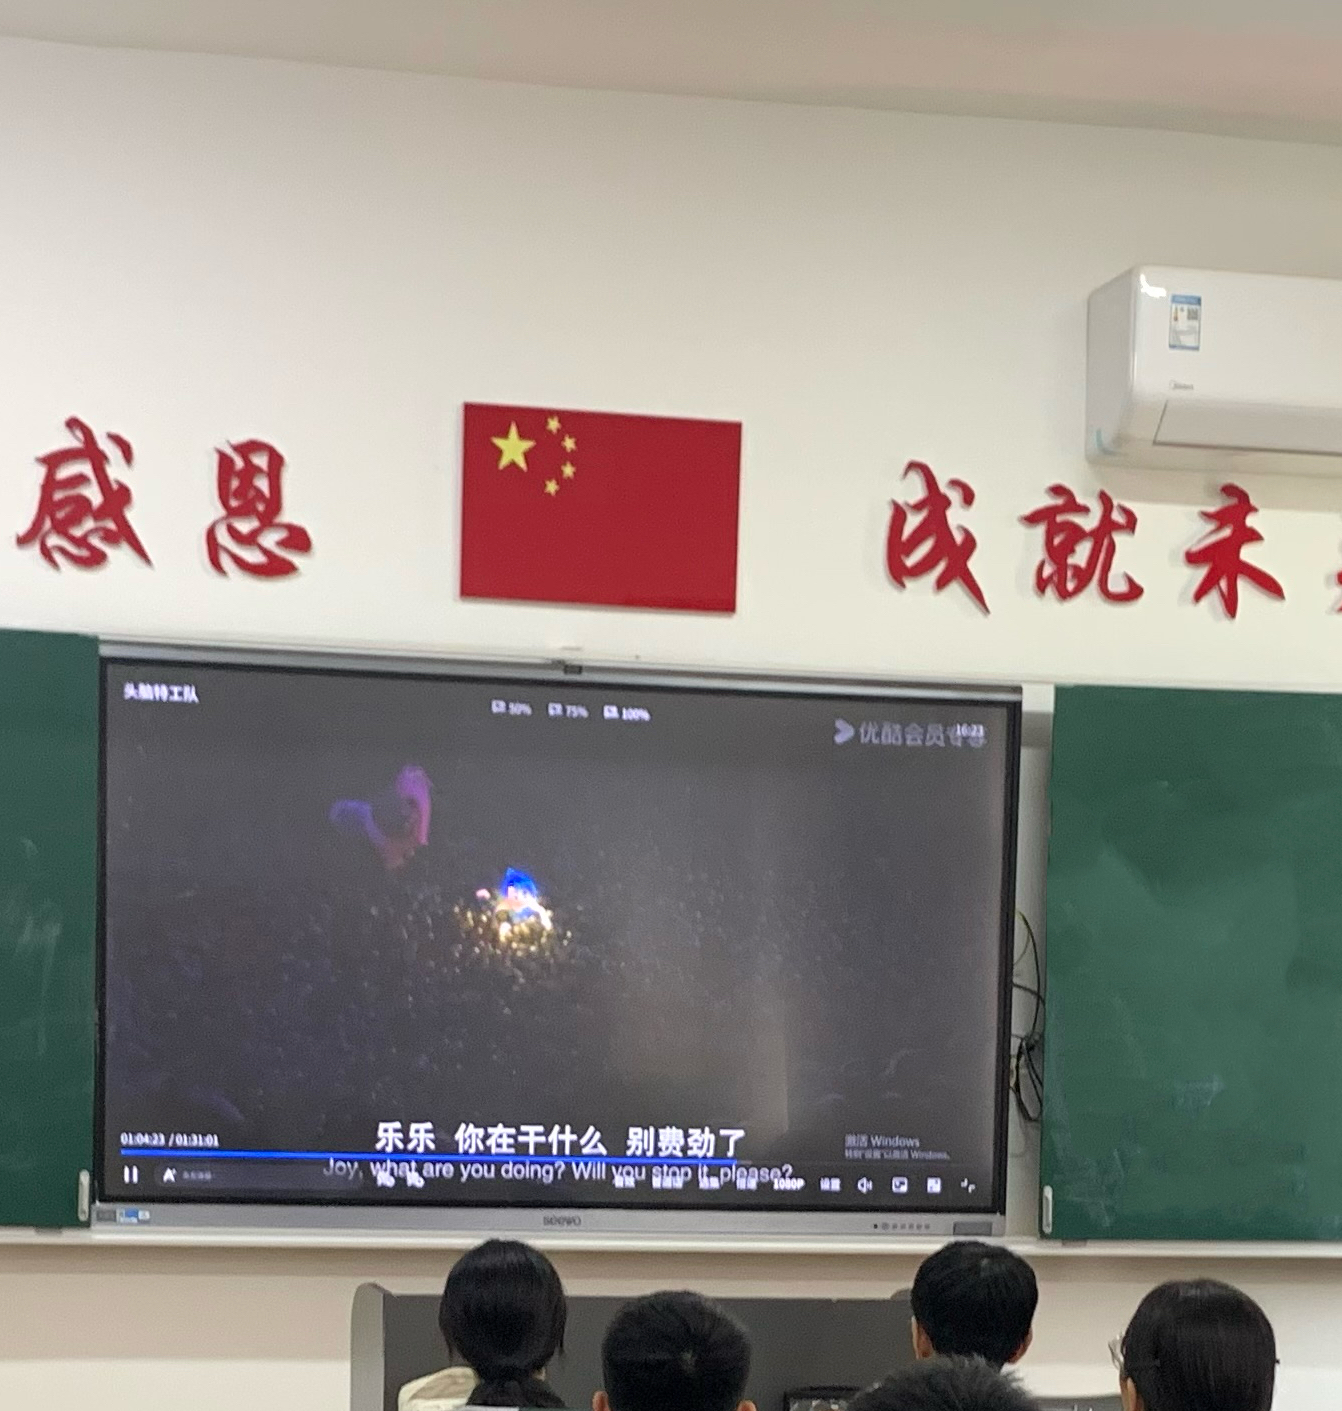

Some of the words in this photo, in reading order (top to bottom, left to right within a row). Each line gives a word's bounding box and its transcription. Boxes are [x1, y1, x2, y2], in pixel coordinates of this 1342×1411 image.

[565, 704, 589, 719] 75%
[621, 706, 651, 722] 100%
[375, 1121, 436, 1153] 乐乐
[454, 1122, 608, 1157] 你在干什么
[626, 1125, 746, 1159] 别费劲了
[870, 1134, 920, 1149] Windows
[323, 1157, 364, 1181] Joy,
[370, 1159, 419, 1178] what
[422, 1161, 455, 1178] are
[460, 1162, 495, 1183] you
[500, 1160, 565, 1185] doing?
[571, 1161, 606, 1180] Will
[611, 1164, 647, 1186] you
[652, 1163, 693, 1187] stop
[719, 1164, 794, 1187] please?
[773, 1178, 806, 1191] 1080P
